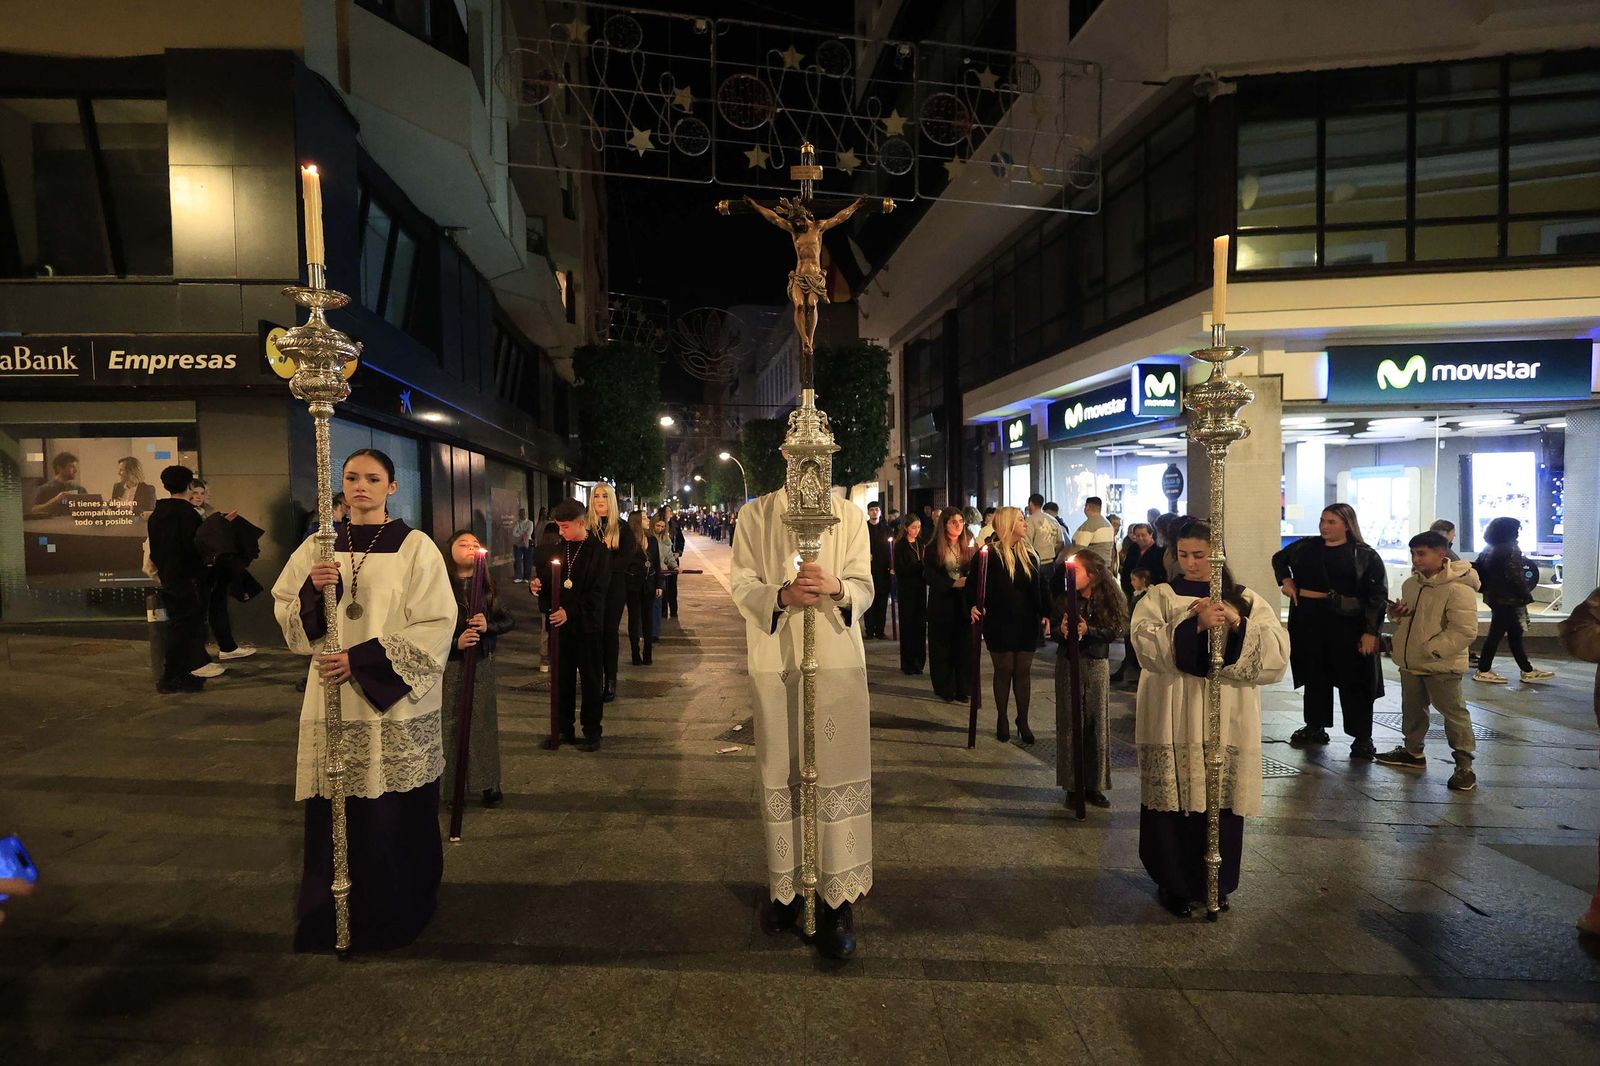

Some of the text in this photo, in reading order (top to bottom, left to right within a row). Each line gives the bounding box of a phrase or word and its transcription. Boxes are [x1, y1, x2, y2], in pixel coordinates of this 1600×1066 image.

[0, 345, 237, 374] aBank Empresas
[1432, 361, 1541, 381] movistar
[1084, 397, 1127, 420] movistar
[109, 499, 138, 508] alguien
[75, 518, 93, 526] todo
